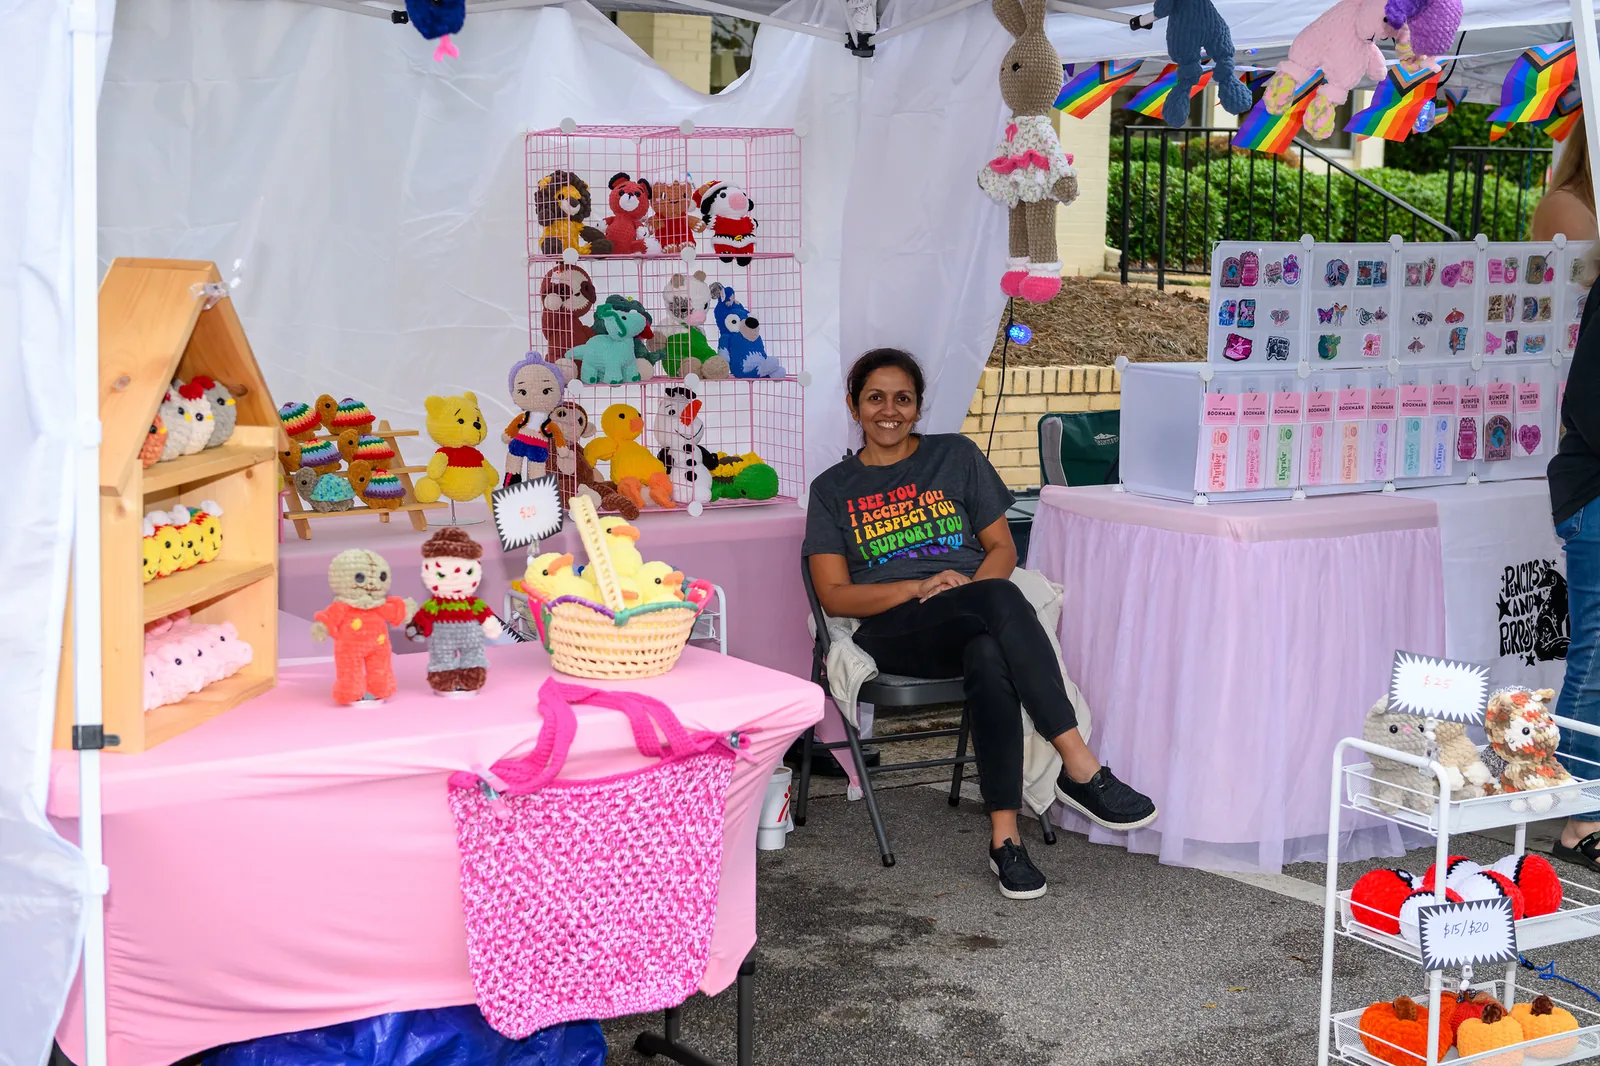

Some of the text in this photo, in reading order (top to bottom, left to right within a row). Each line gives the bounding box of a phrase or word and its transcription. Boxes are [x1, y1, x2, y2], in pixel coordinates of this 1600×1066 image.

[1278, 452, 1287, 480] Horror
[847, 483, 917, 513] I SEE YOU
[849, 489, 945, 527] I ACCEPT YOU
[854, 500, 956, 544] I RESPECT YOU
[859, 545, 870, 560] I
[869, 522, 934, 556] SUPPORT
[936, 515, 963, 535] YOU
[1504, 559, 1540, 598] PENCILS
[1513, 594, 1534, 618] AND
[1423, 673, 1454, 690] $25
[1443, 919, 1490, 939] $15/$20
